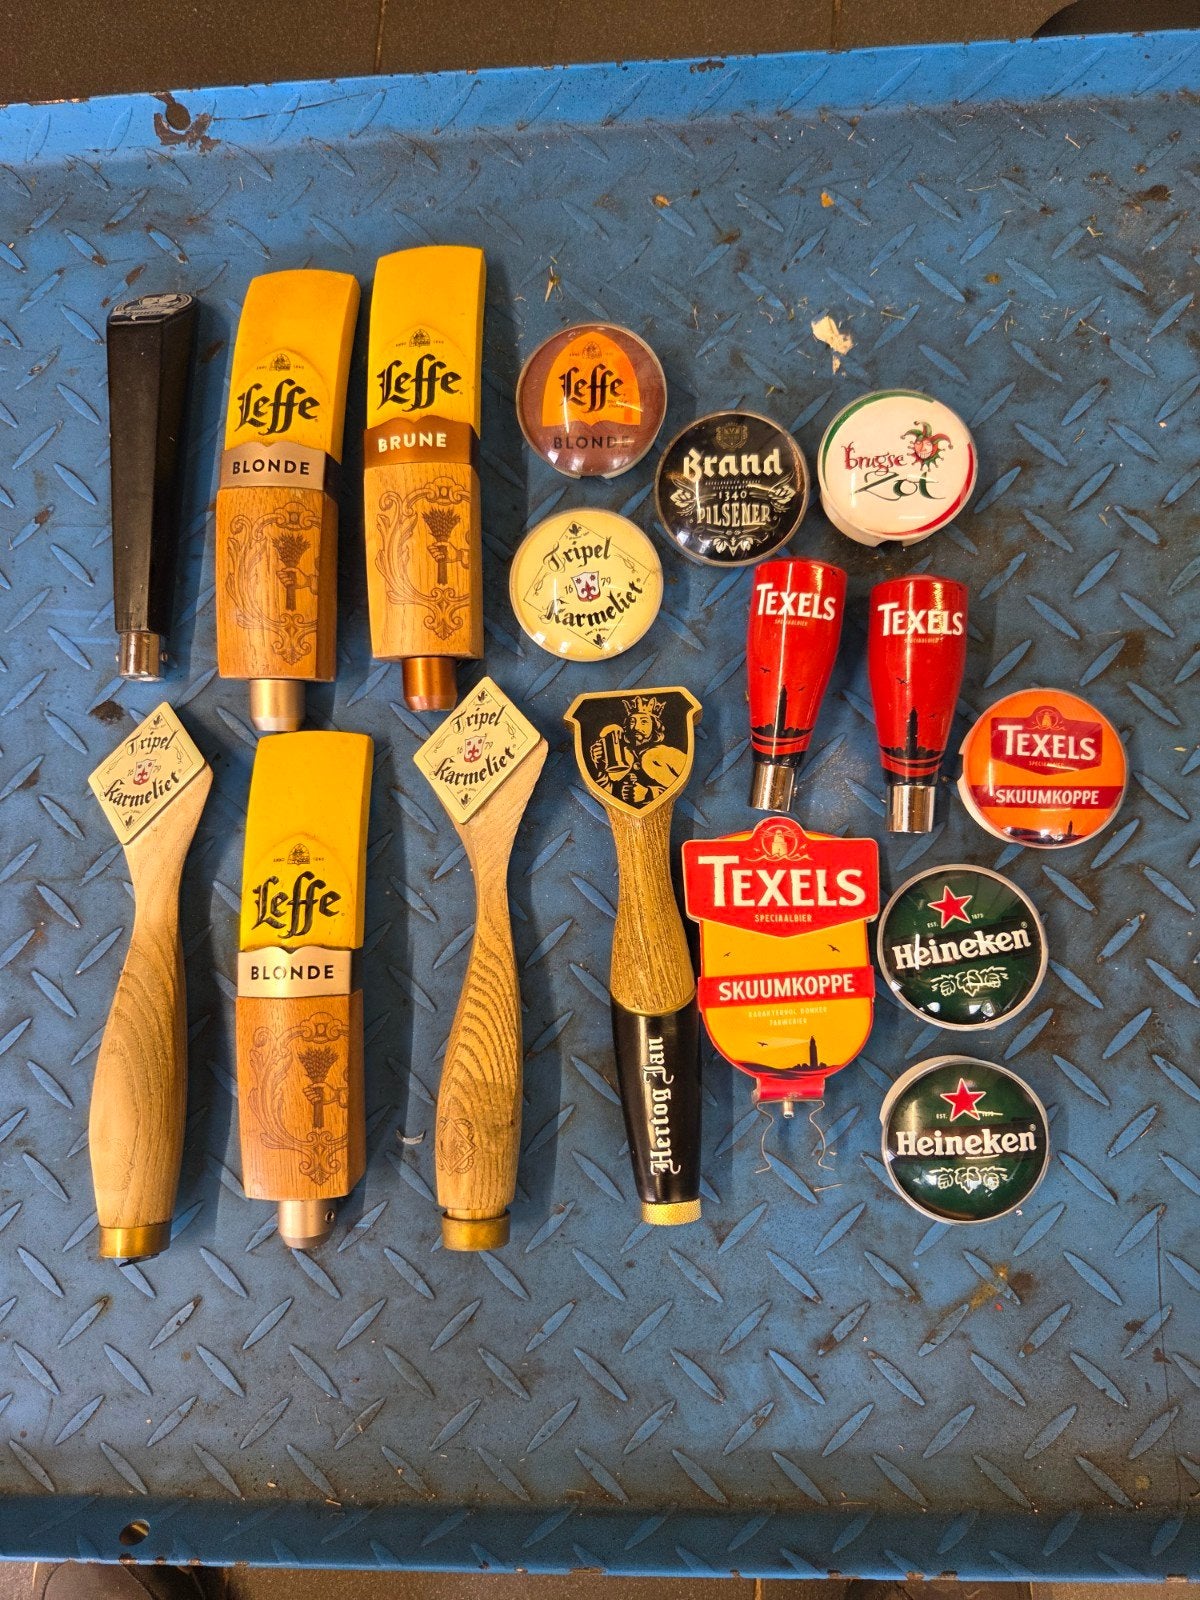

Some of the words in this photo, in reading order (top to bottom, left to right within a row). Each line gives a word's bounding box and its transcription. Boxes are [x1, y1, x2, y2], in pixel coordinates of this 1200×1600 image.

[377, 353, 462, 413] Leffe
[558, 363, 625, 414] Leffe
[234, 378, 321, 436] Leffe
[377, 432, 448, 453] BRUNE
[553, 435, 632, 450] BLONDE
[232, 458, 311, 475] BLONDE
[683, 447, 783, 483] Brand
[718, 490, 747, 502] 1340
[696, 502, 772, 527] PILSENER
[543, 536, 613, 573] Tripel
[538, 579, 644, 628] Karmeliet
[450, 704, 508, 735] Tripel
[124, 730, 181, 756] Tripel
[430, 746, 516, 786] Karmeliet
[101, 771, 180, 808] Karmeliet
[995, 789, 1100, 805] SKUUMKOPPE
[251, 870, 342, 939] Leffe
[754, 913, 813, 923] SPECIAALBIER
[891, 930, 1032, 970] Heineken
[251, 965, 334, 980] BLONDE
[718, 973, 855, 1001] SKUUMKOPPE
[643, 1036, 675, 1085] Jan
[649, 1088, 682, 1176] Hertog
[896, 1129, 1037, 1156] Heineken
